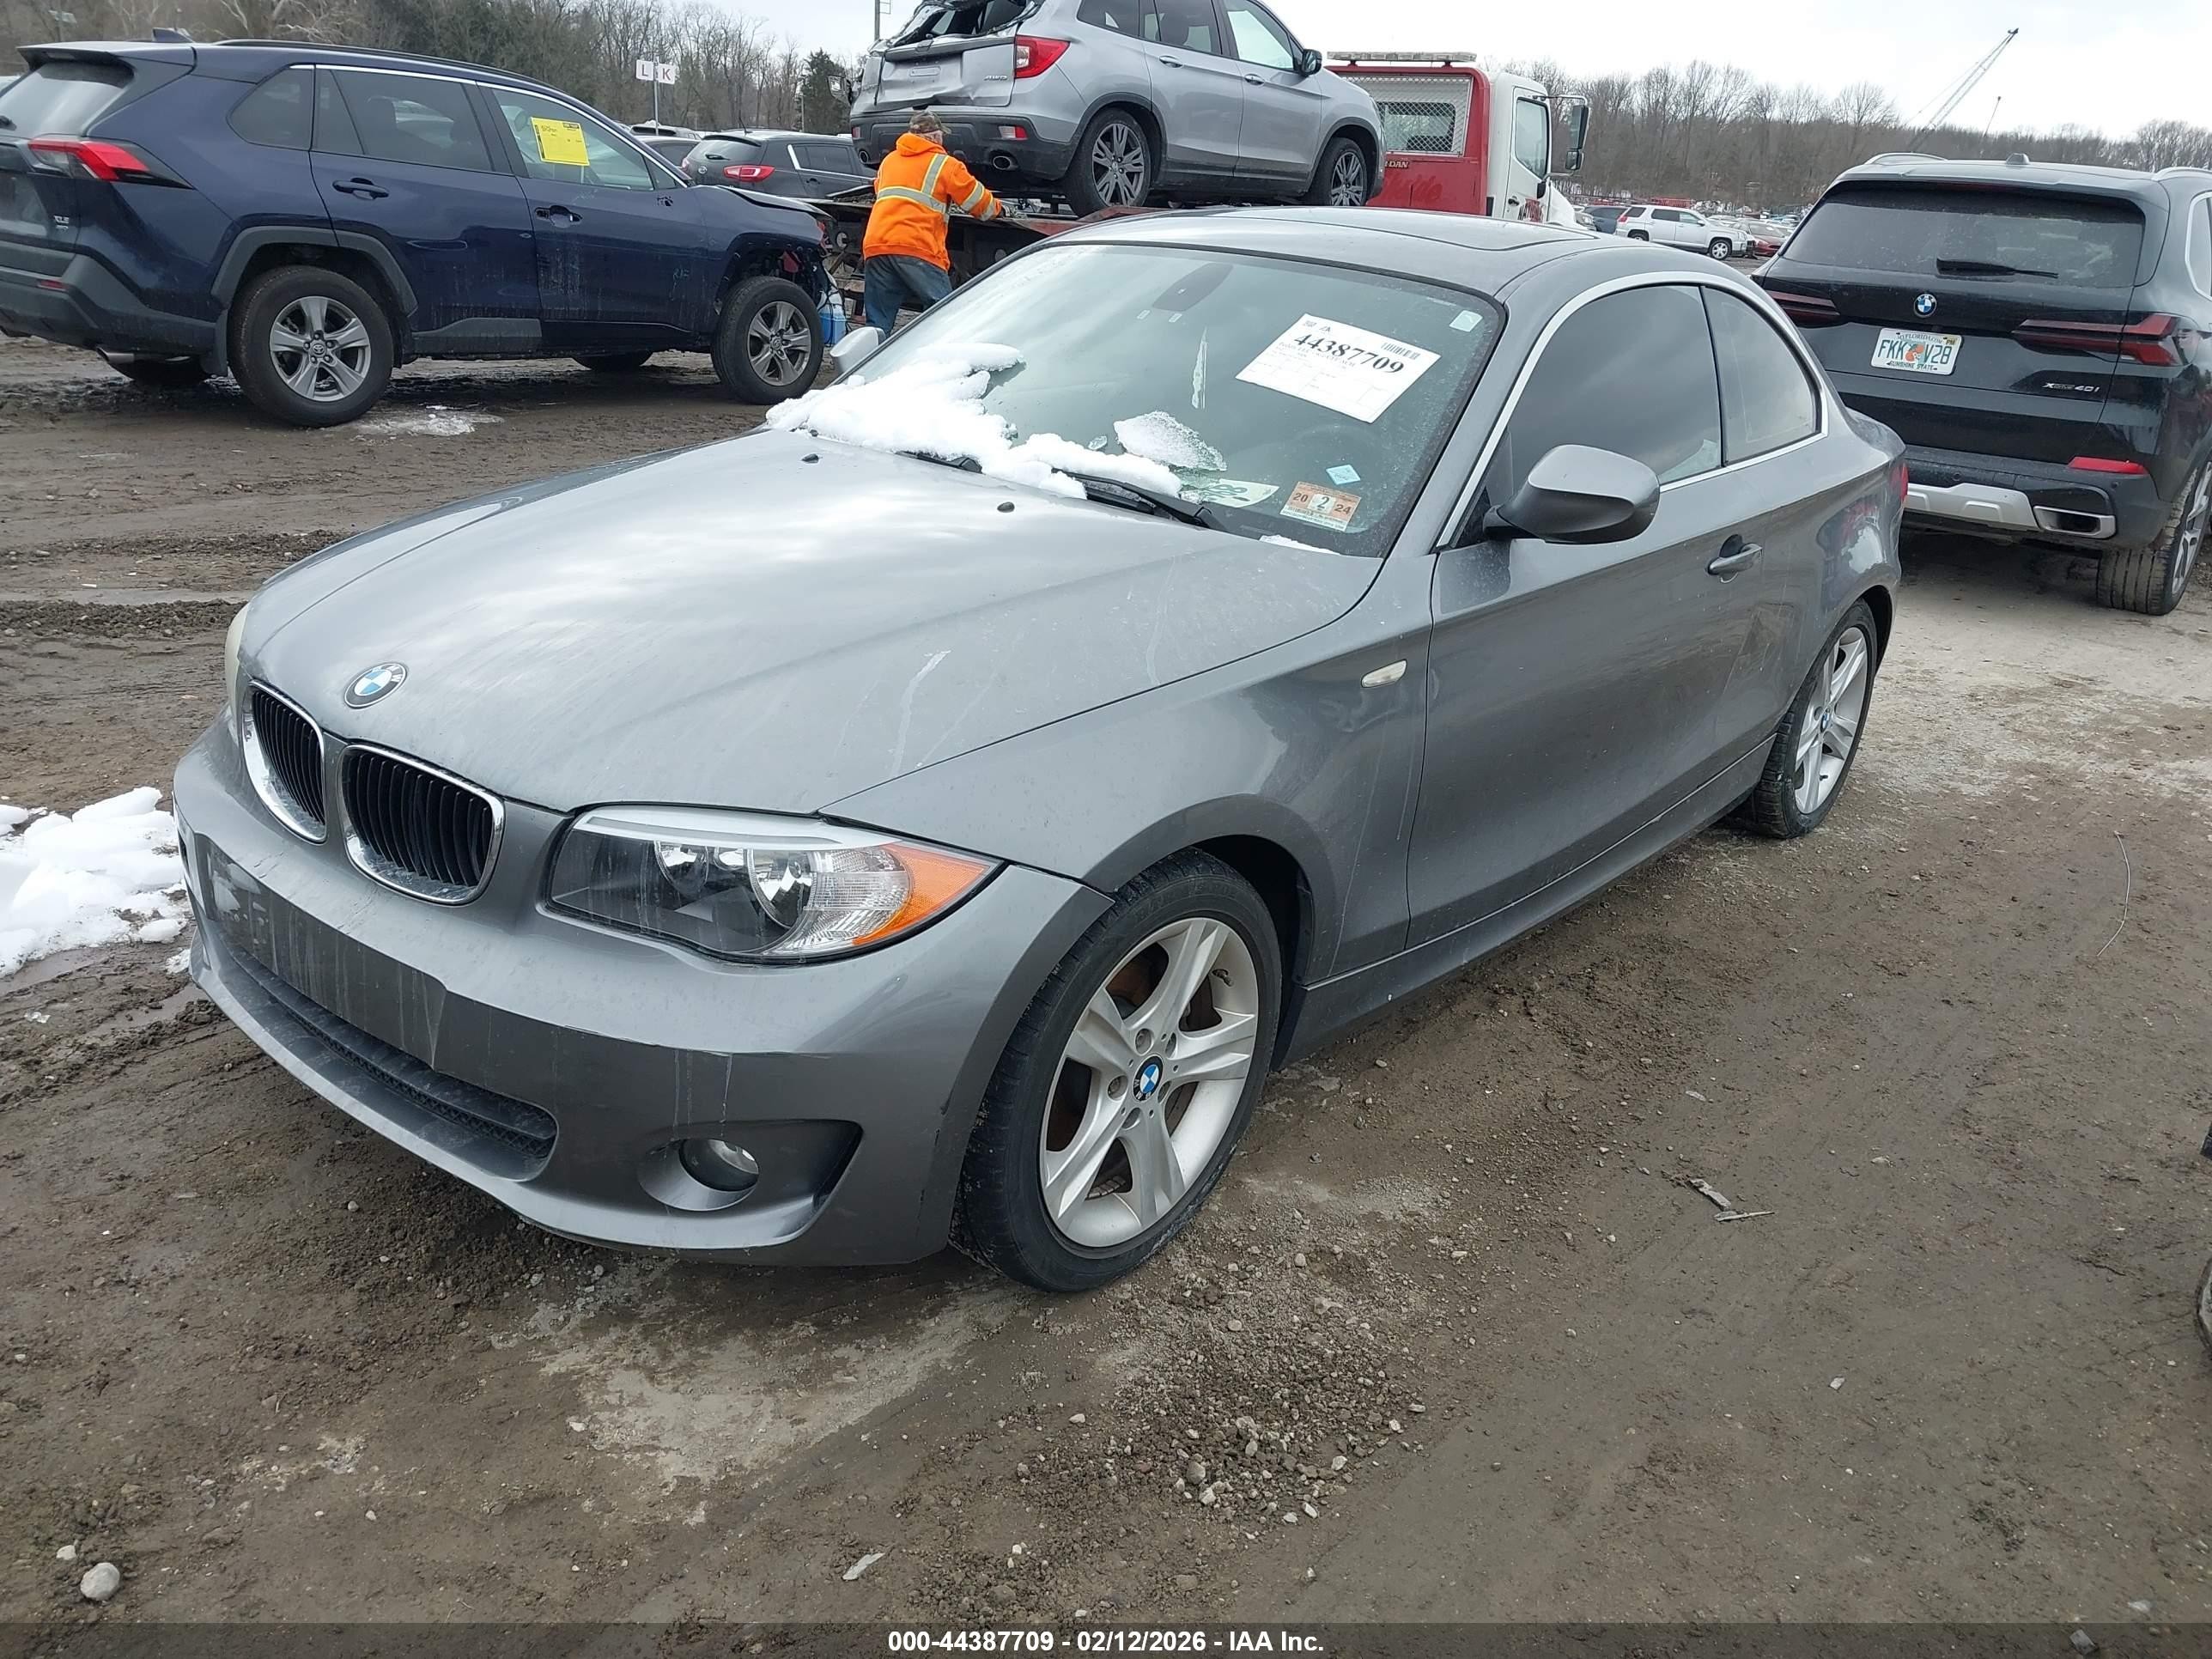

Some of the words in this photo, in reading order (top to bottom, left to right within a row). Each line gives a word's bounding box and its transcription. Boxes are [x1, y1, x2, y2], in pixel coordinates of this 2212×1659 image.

[641, 64, 649, 77] L
[662, 68, 672, 81] K
[1294, 334, 1405, 374] 44387709
[1877, 339, 1908, 361] FKK
[1923, 343, 1953, 365] V28
[1292, 492, 1309, 503] 20
[1316, 495, 1330, 509] 2
[1334, 503, 1352, 515] 24
